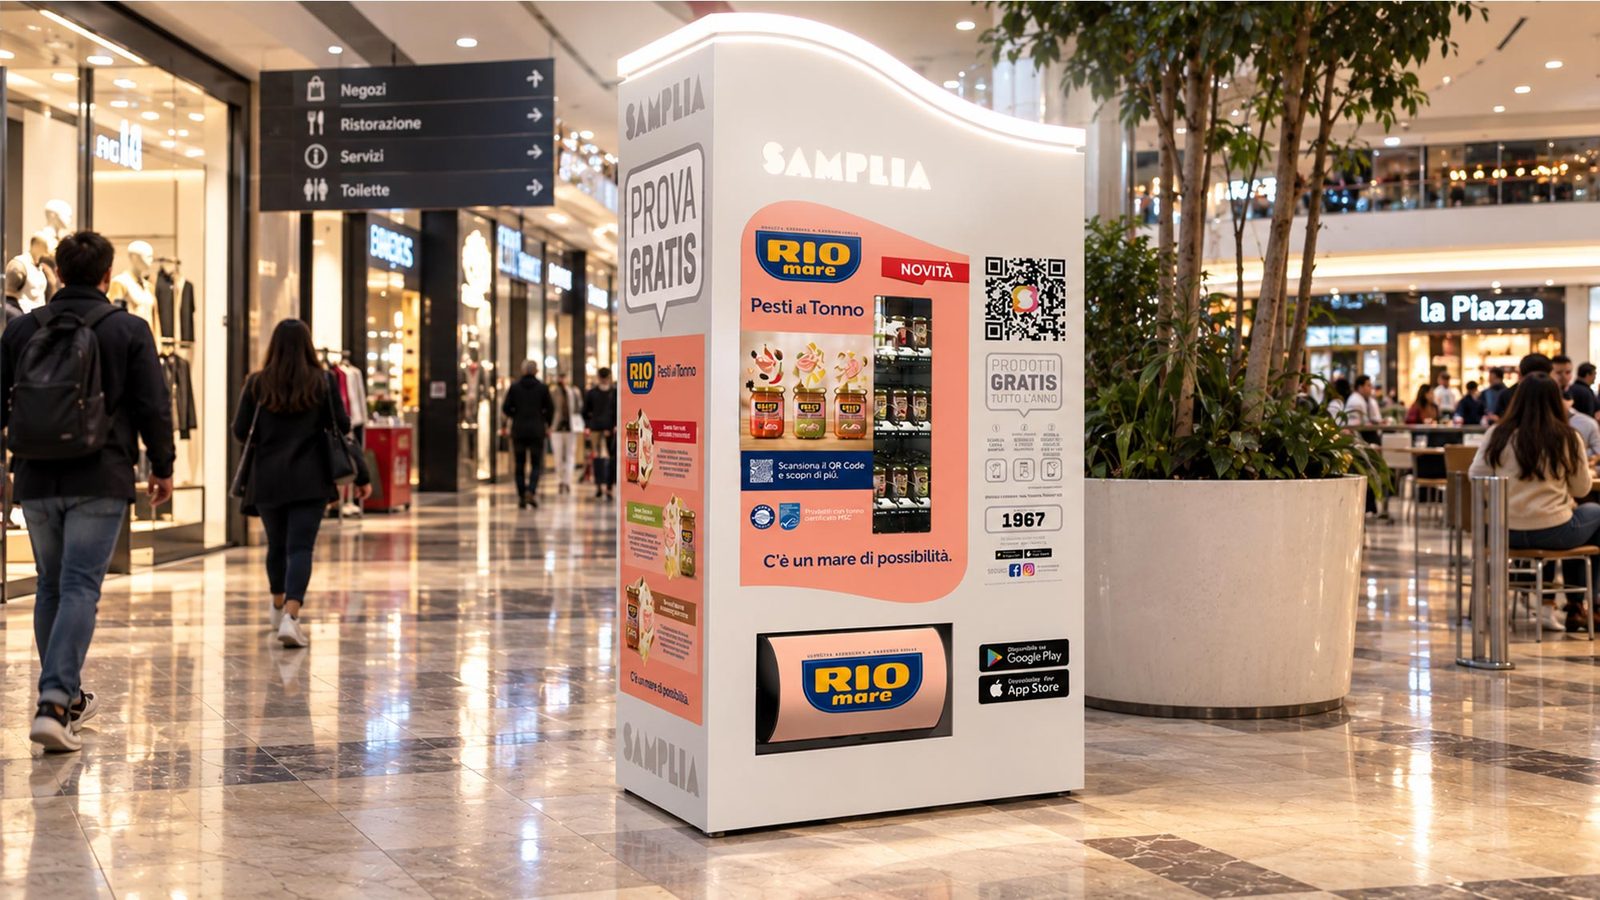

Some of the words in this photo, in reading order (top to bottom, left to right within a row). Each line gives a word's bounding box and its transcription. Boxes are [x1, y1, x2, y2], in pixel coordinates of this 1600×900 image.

[341, 82, 386, 100] Negozi
[626, 74, 705, 141] SAMPLIA
[341, 116, 422, 131] Ristorazione
[341, 149, 384, 163] Servizi
[762, 141, 932, 190] SAMPLIA
[340, 183, 390, 197] Toilette
[631, 166, 696, 238] PROVA
[767, 239, 850, 266] RIO
[630, 232, 696, 296] GRATIS
[783, 265, 836, 277] mare
[901, 263, 953, 278] NOVITÀ
[751, 298, 792, 314] Pesti
[796, 304, 806, 315] al
[809, 300, 864, 317] Tonno
[1421, 296, 1446, 322] la
[1452, 294, 1544, 321] Piazza
[629, 362, 653, 380] RIO
[992, 359, 1056, 372] PRODOTTI
[991, 374, 1057, 391] GRATIS
[992, 394, 1021, 403] TUTTO
[1024, 393, 1058, 403] L'ANNO
[778, 461, 820, 470] Scansiona
[829, 462, 842, 470] QR
[843, 461, 865, 470] Code
[1002, 512, 1046, 528] 1967
[763, 553, 790, 568] C'è
[793, 554, 813, 567] un
[817, 554, 856, 566] mare
[860, 551, 874, 565] di
[877, 549, 952, 567] possibilità.
[1007, 653, 1041, 665] Google
[1042, 650, 1062, 663] Play
[815, 662, 910, 693] RIO
[832, 690, 892, 705] mare
[1008, 685, 1030, 698] App
[1032, 683, 1060, 693] Store
[623, 722, 700, 798] SAMPLIA
